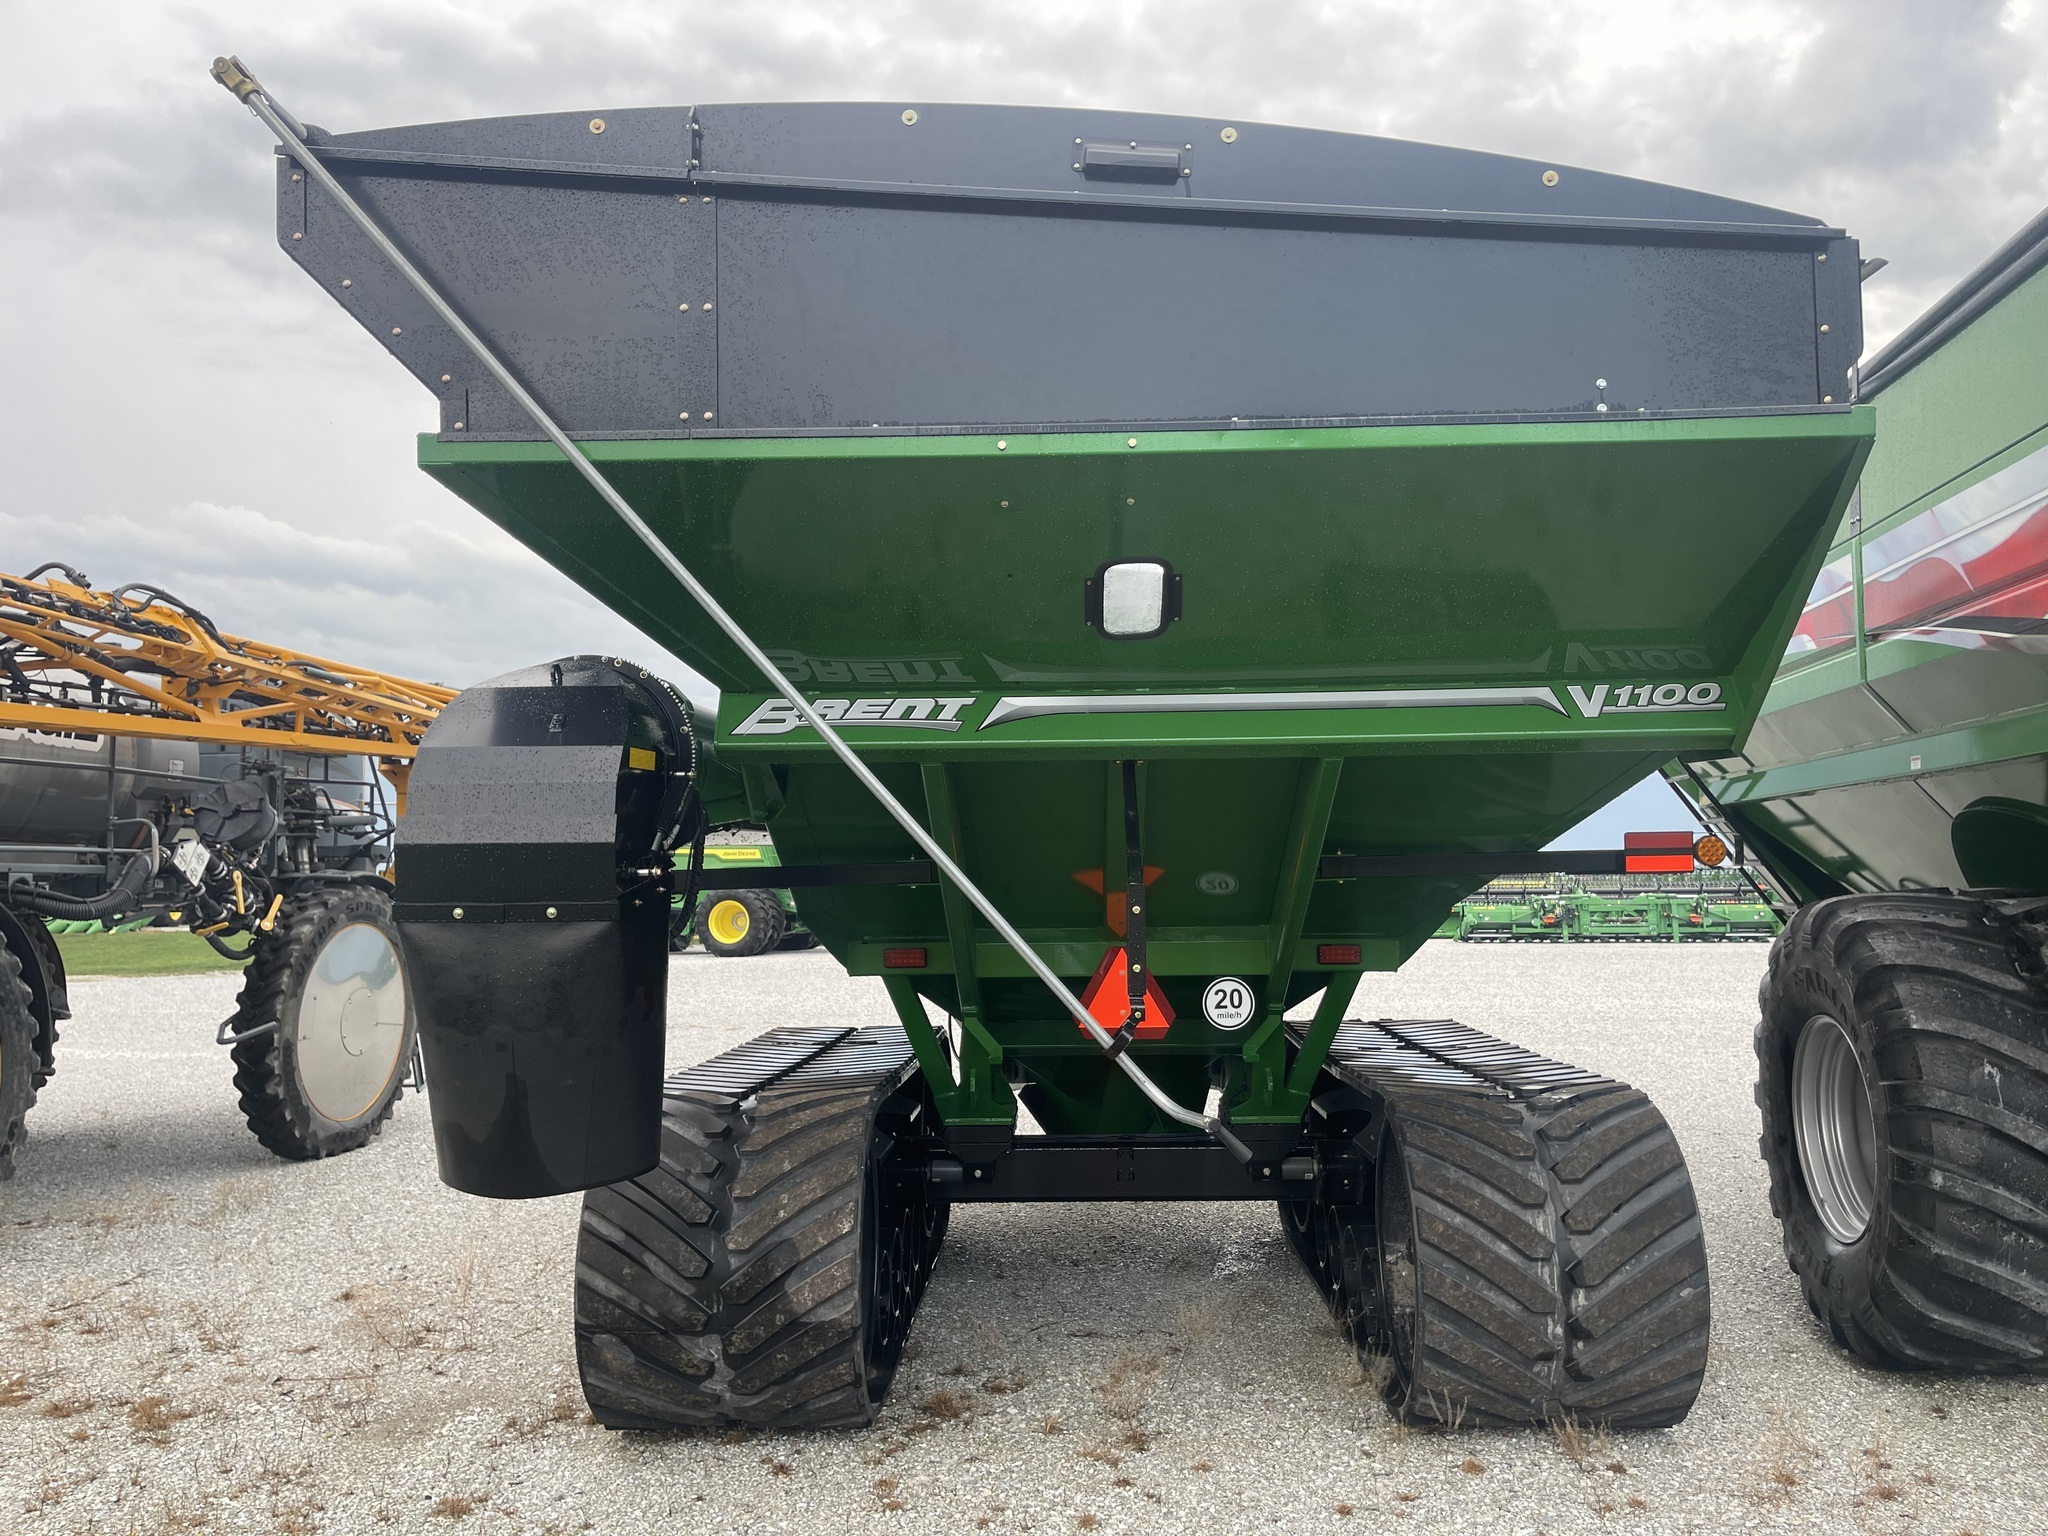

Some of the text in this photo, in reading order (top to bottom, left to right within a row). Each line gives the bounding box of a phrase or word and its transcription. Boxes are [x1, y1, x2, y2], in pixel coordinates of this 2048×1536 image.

[729, 697, 977, 735] BRENT
[1214, 988, 1243, 1009] 20
[1216, 1011, 1242, 1019] mile/h
